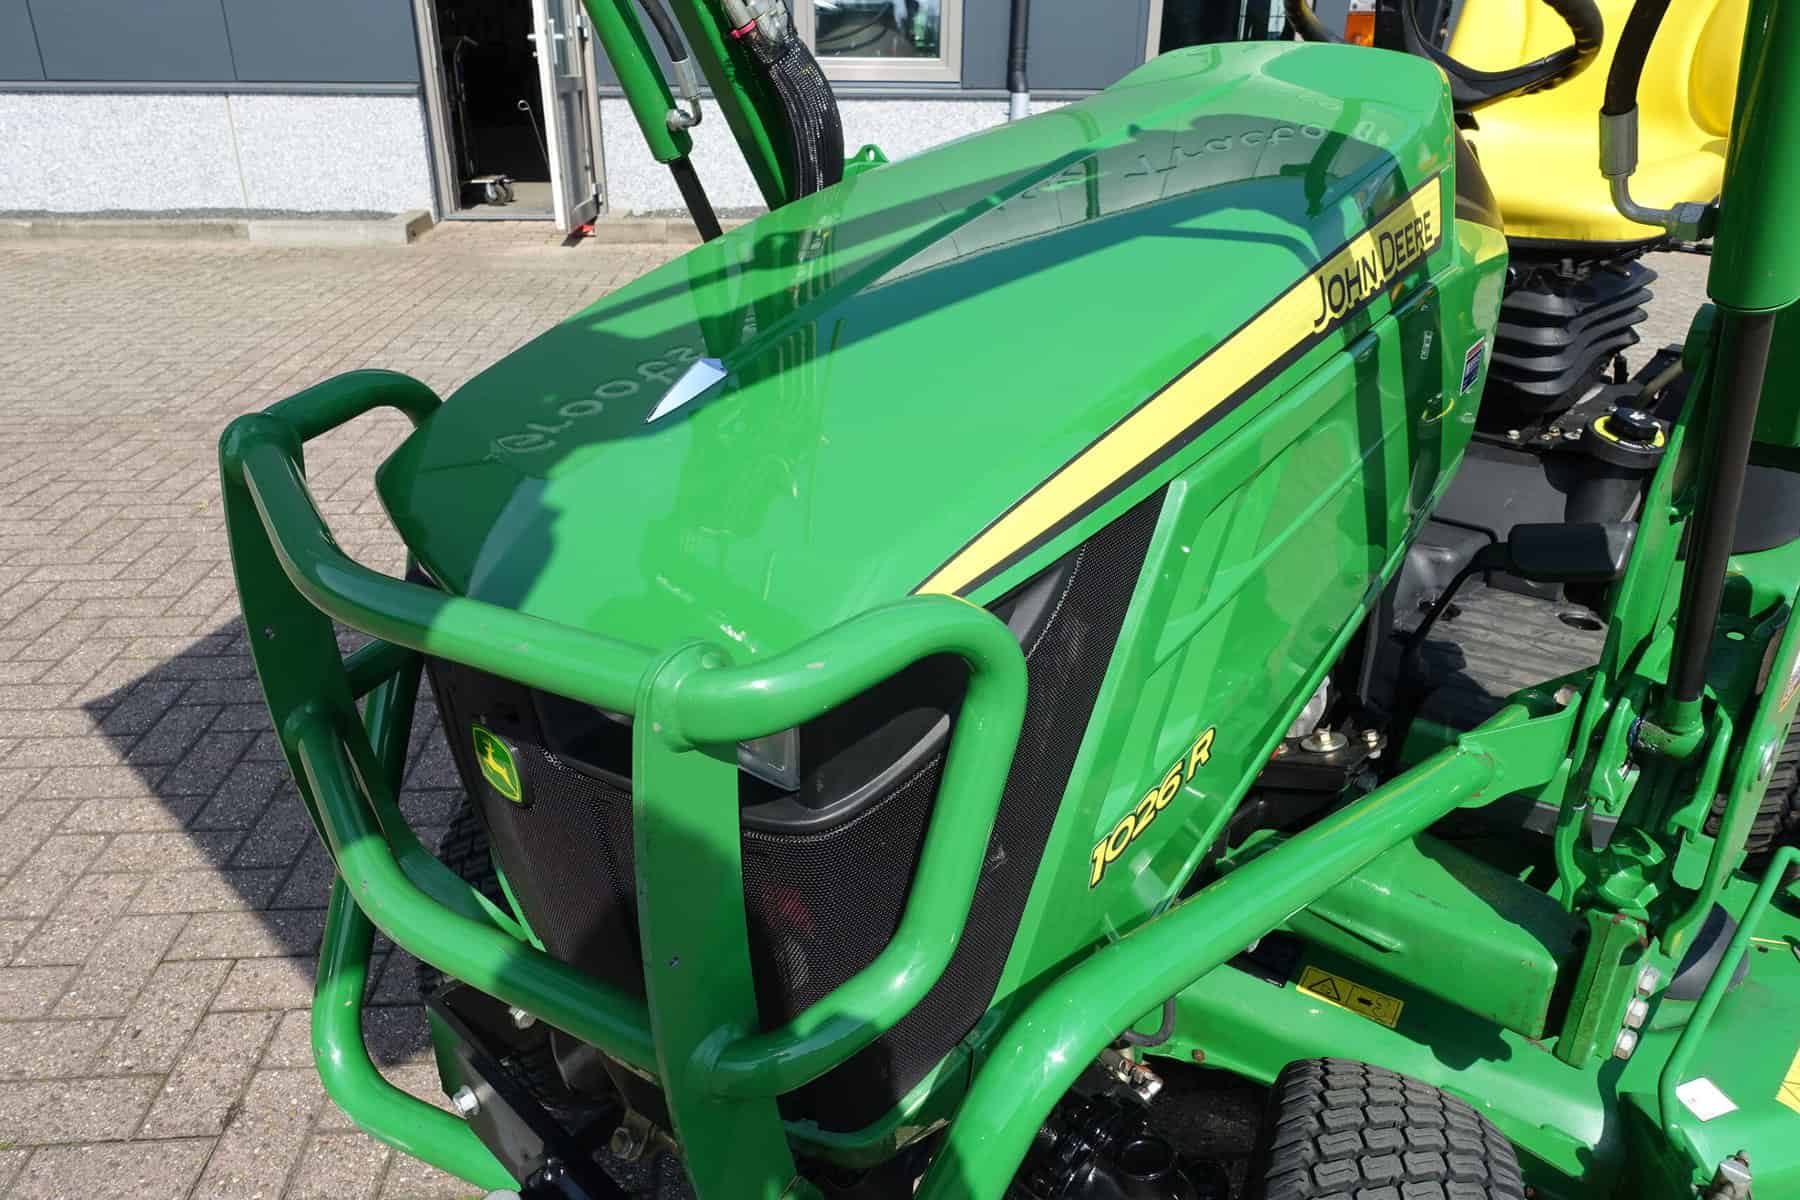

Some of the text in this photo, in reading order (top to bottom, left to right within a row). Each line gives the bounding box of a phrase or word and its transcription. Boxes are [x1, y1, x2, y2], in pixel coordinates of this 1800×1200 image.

[1314, 210, 1433, 328] JOHN DEERE
[1088, 726, 1217, 889] 1026R
